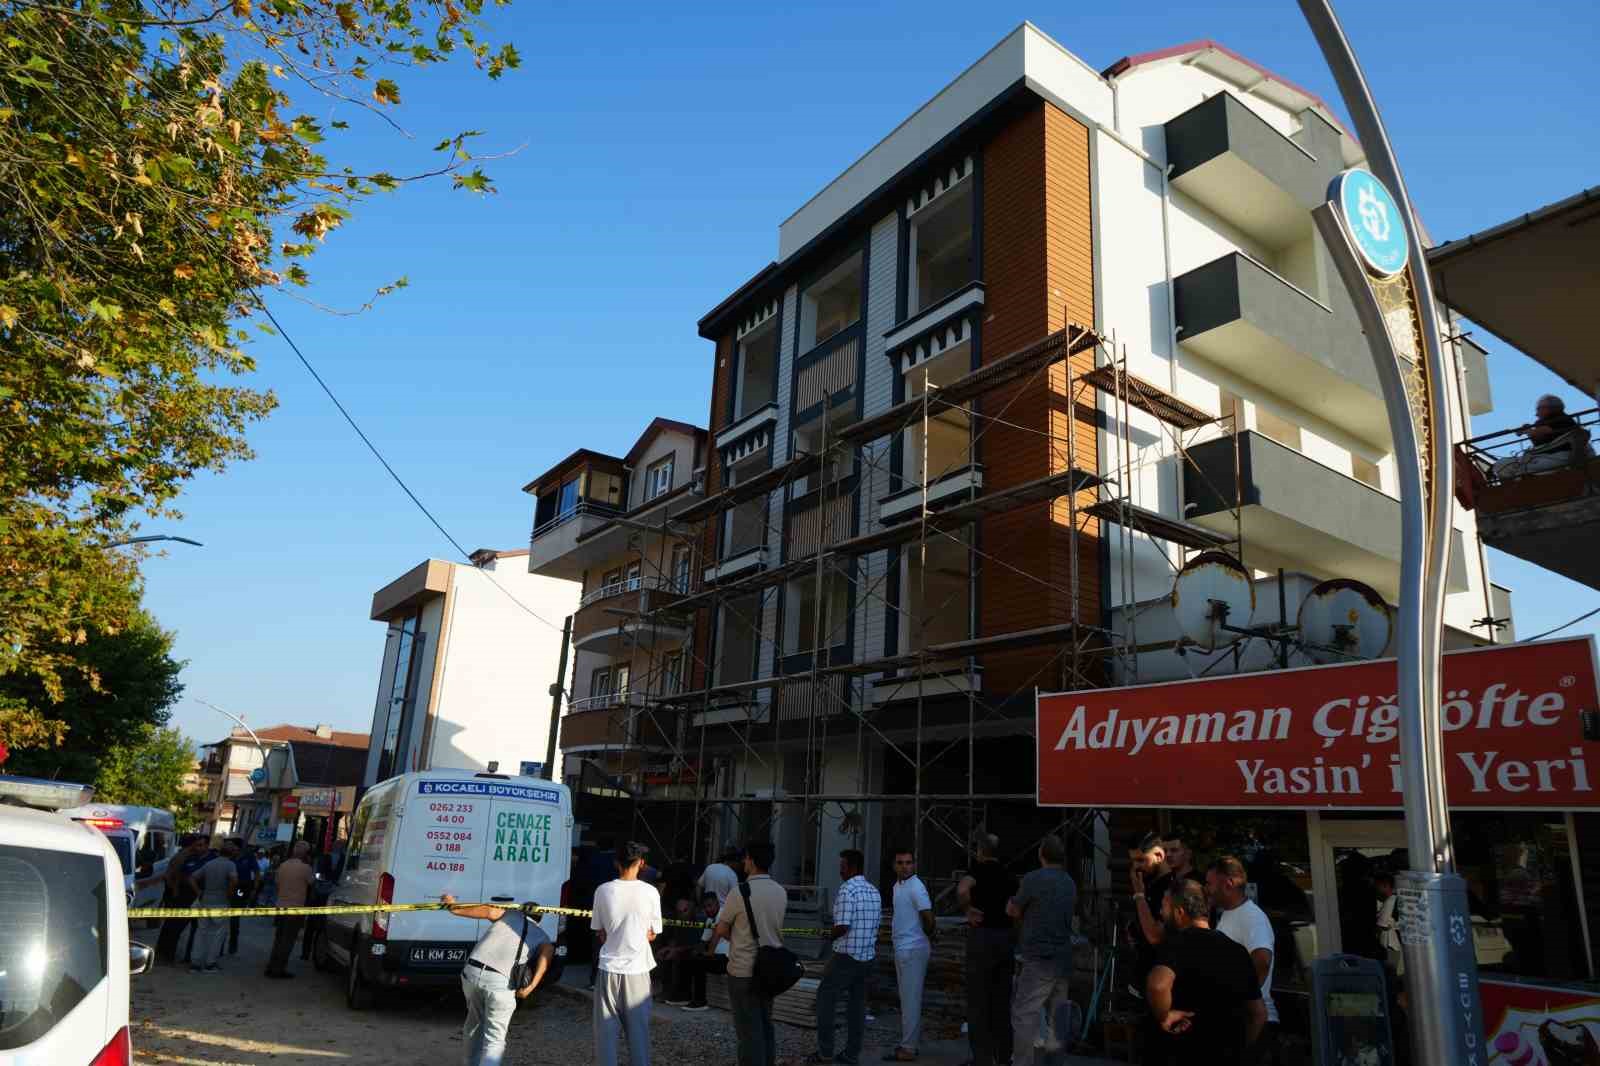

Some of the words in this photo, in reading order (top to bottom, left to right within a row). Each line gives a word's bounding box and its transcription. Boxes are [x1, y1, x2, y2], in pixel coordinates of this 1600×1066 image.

[1055, 705, 1293, 756] Adıyaman
[1456, 746, 1593, 793] Yeri
[430, 803, 454, 812] 0262
[456, 804, 473, 813] 233
[436, 815, 451, 823] 44
[452, 815, 465, 824] 00
[497, 812, 552, 830] CENAZE
[426, 832, 451, 841] 0552
[453, 832, 472, 841] 084
[445, 843, 461, 852] 188
[493, 846, 549, 863] ARACI
[414, 949, 424, 960] 41
[428, 950, 444, 960] KM
[447, 950, 465, 960] 347
